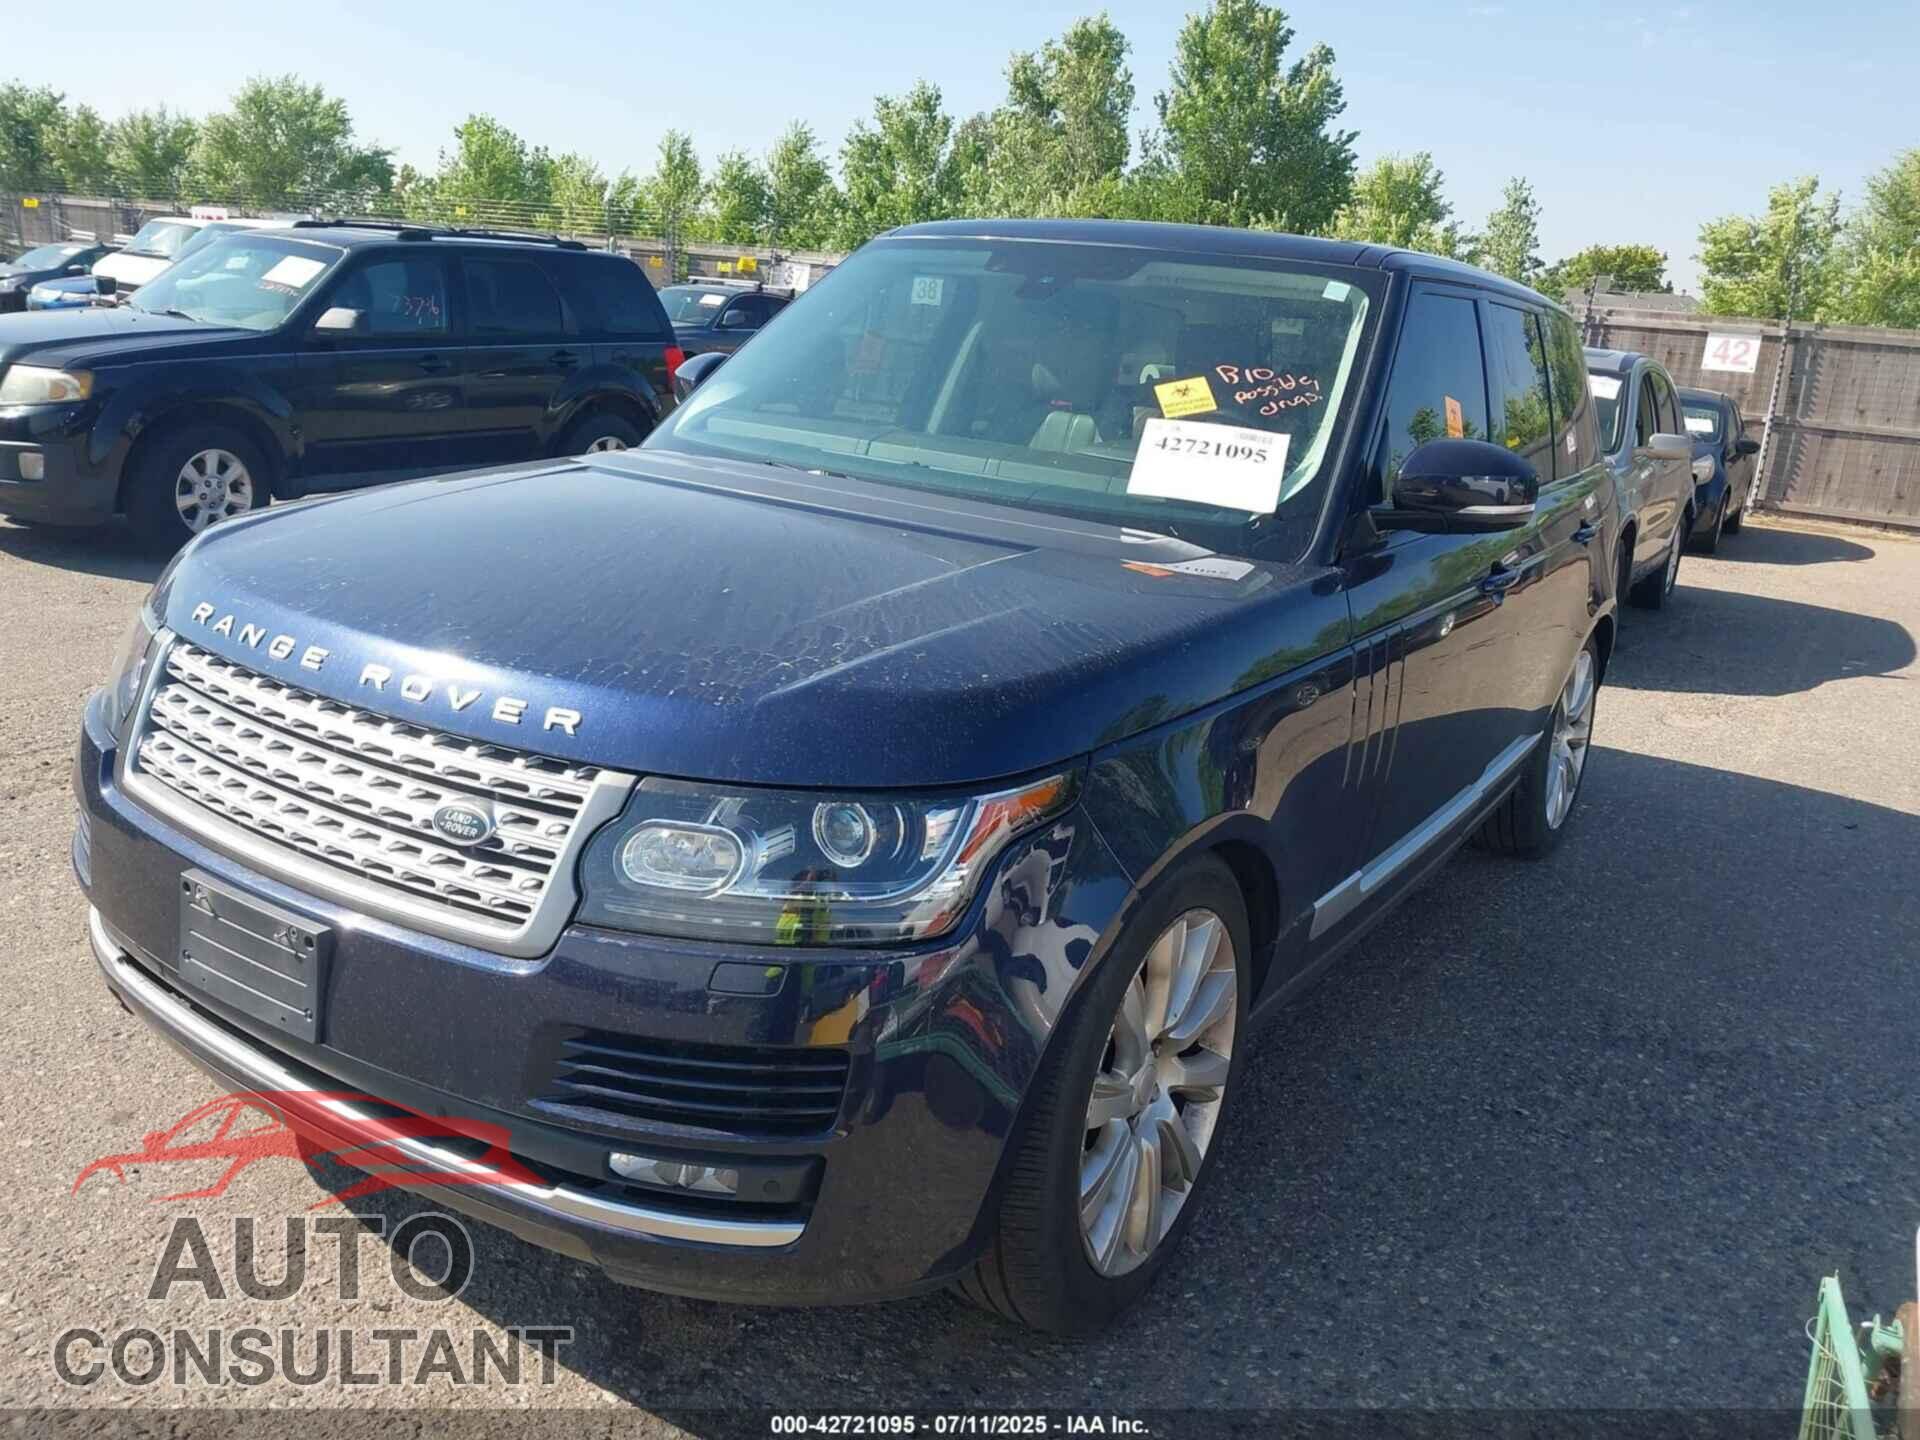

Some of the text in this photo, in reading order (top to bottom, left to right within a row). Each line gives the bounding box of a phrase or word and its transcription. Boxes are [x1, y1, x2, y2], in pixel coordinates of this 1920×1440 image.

[1712, 336, 1753, 366] 42
[1154, 436, 1268, 464] 42721095
[191, 602, 584, 736] RANGE ROVER
[444, 808, 473, 825] LAND
[444, 820, 479, 838] ROVER
